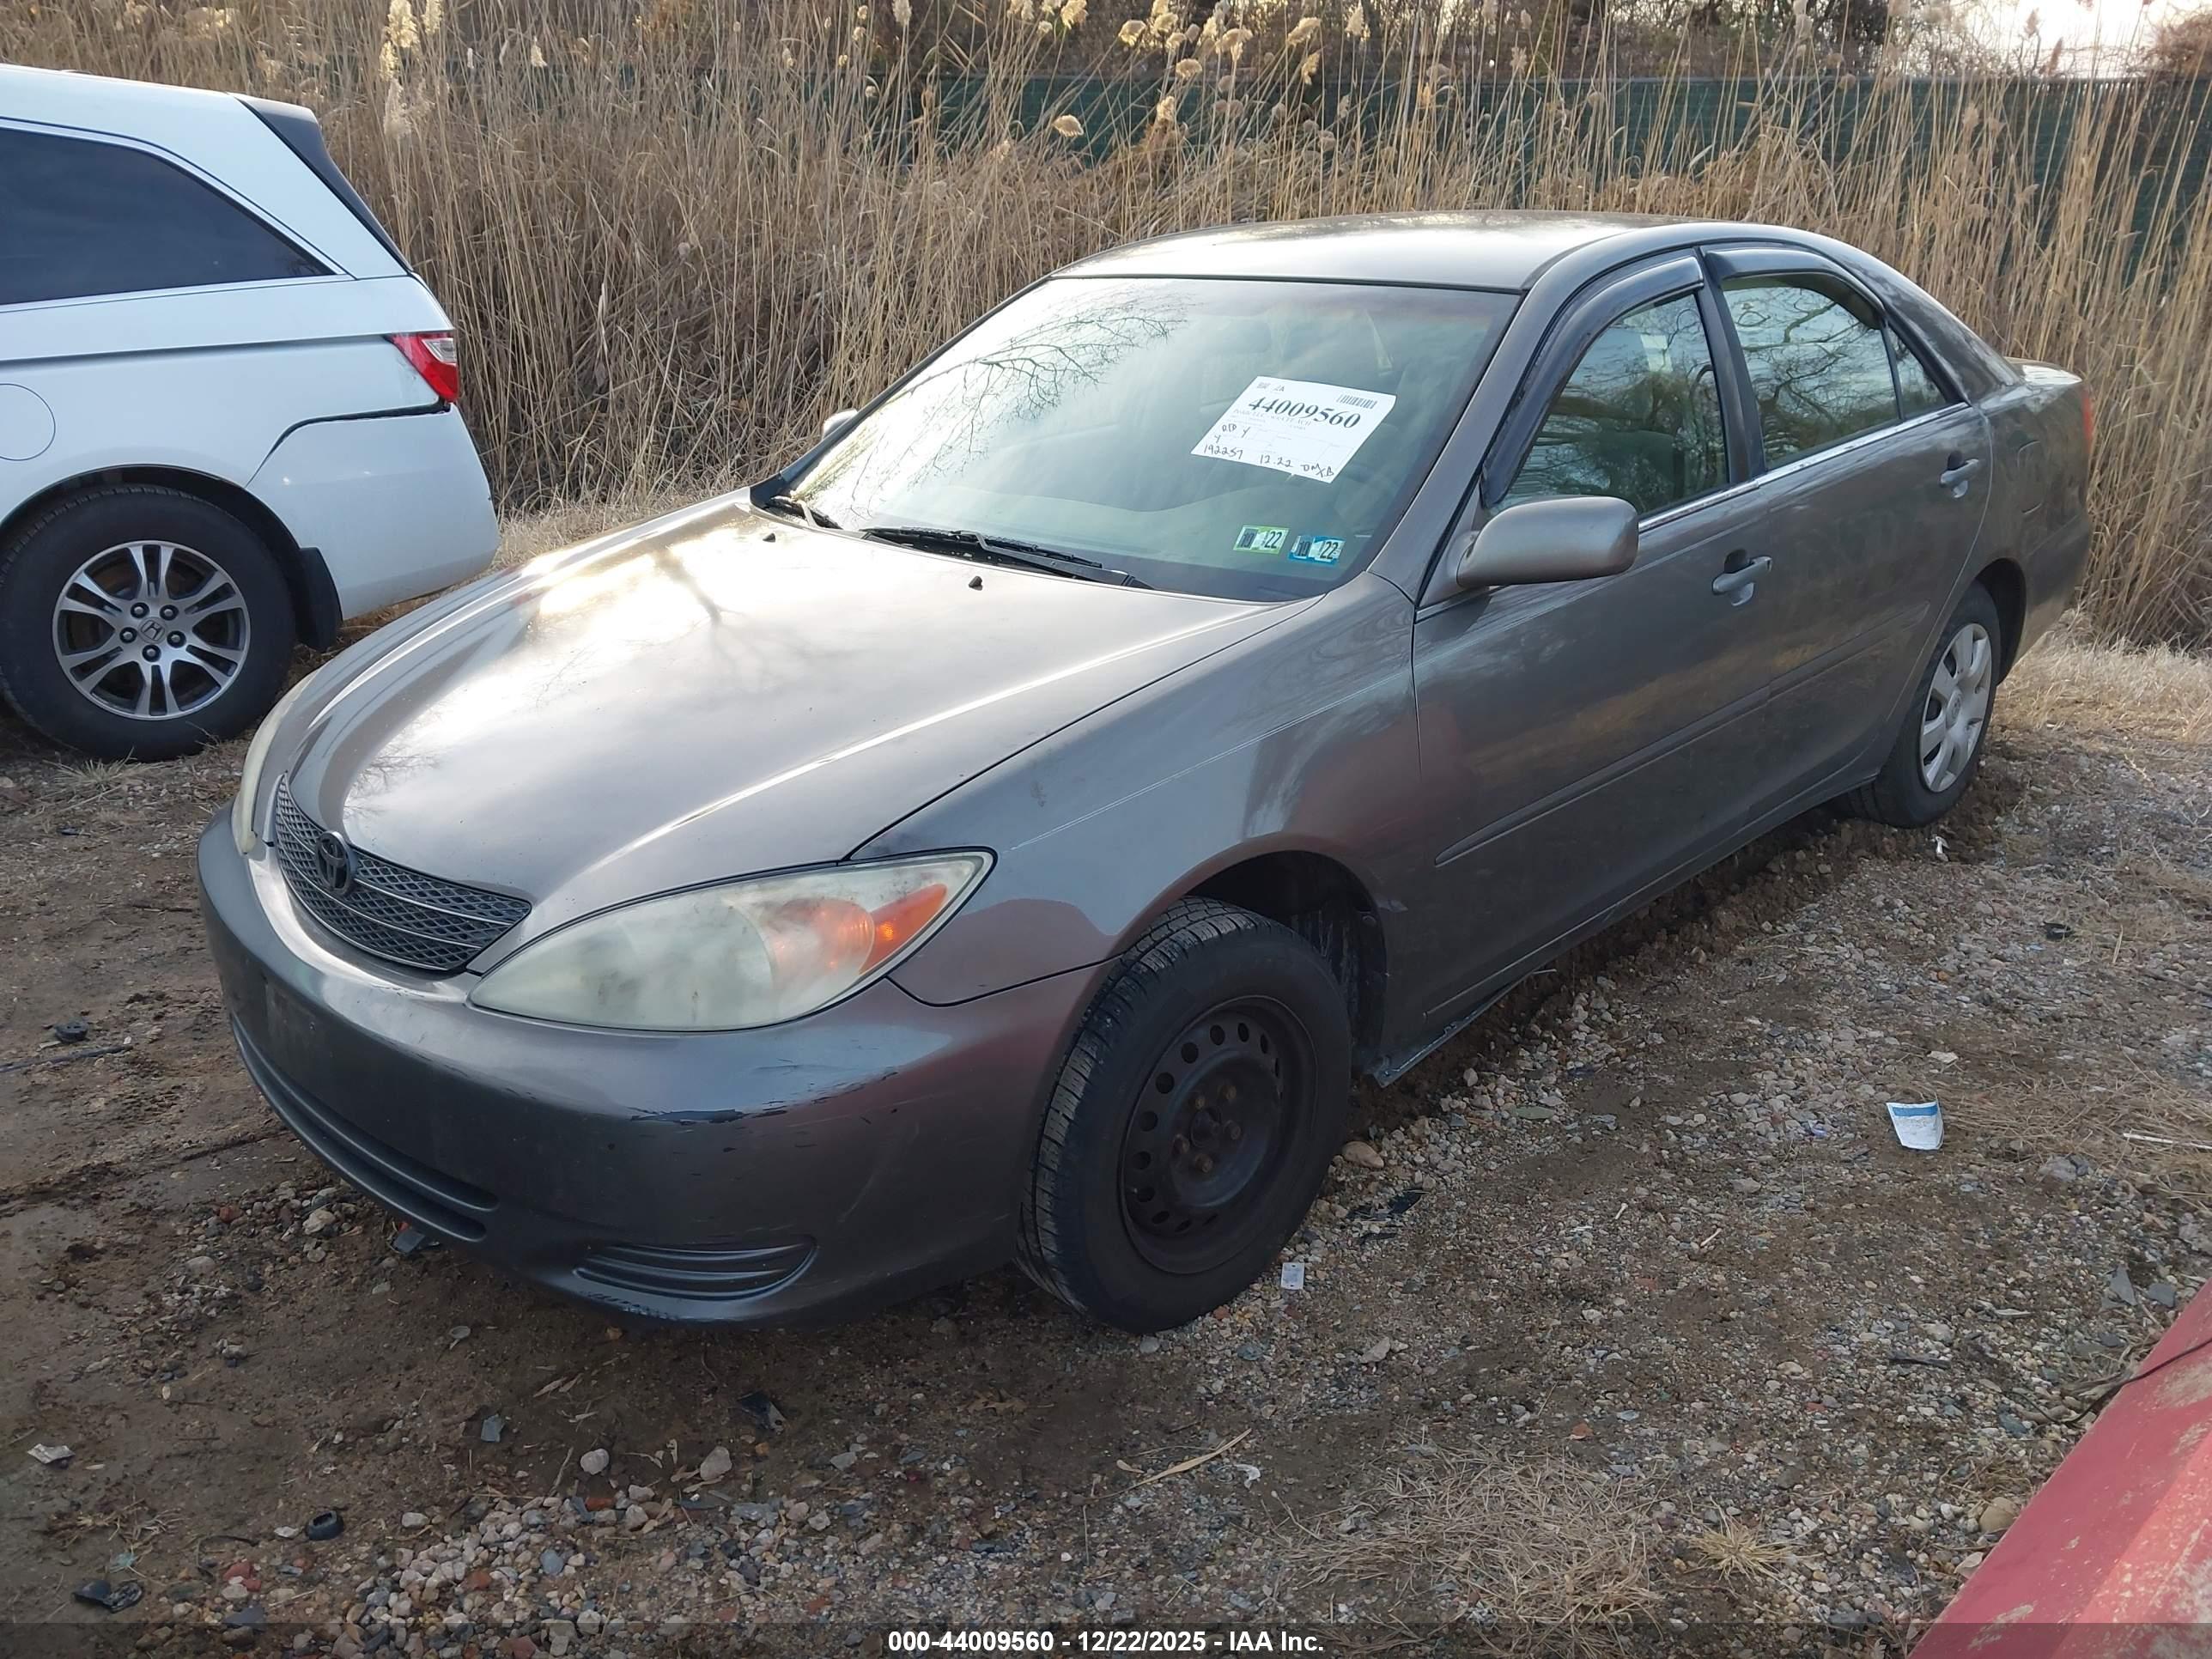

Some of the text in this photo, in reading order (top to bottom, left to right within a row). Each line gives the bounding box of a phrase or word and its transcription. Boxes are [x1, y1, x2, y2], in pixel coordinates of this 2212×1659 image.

[1249, 397, 1361, 428] 44009560
[1264, 531, 1283, 549] 22
[1320, 541, 1339, 559] 22
